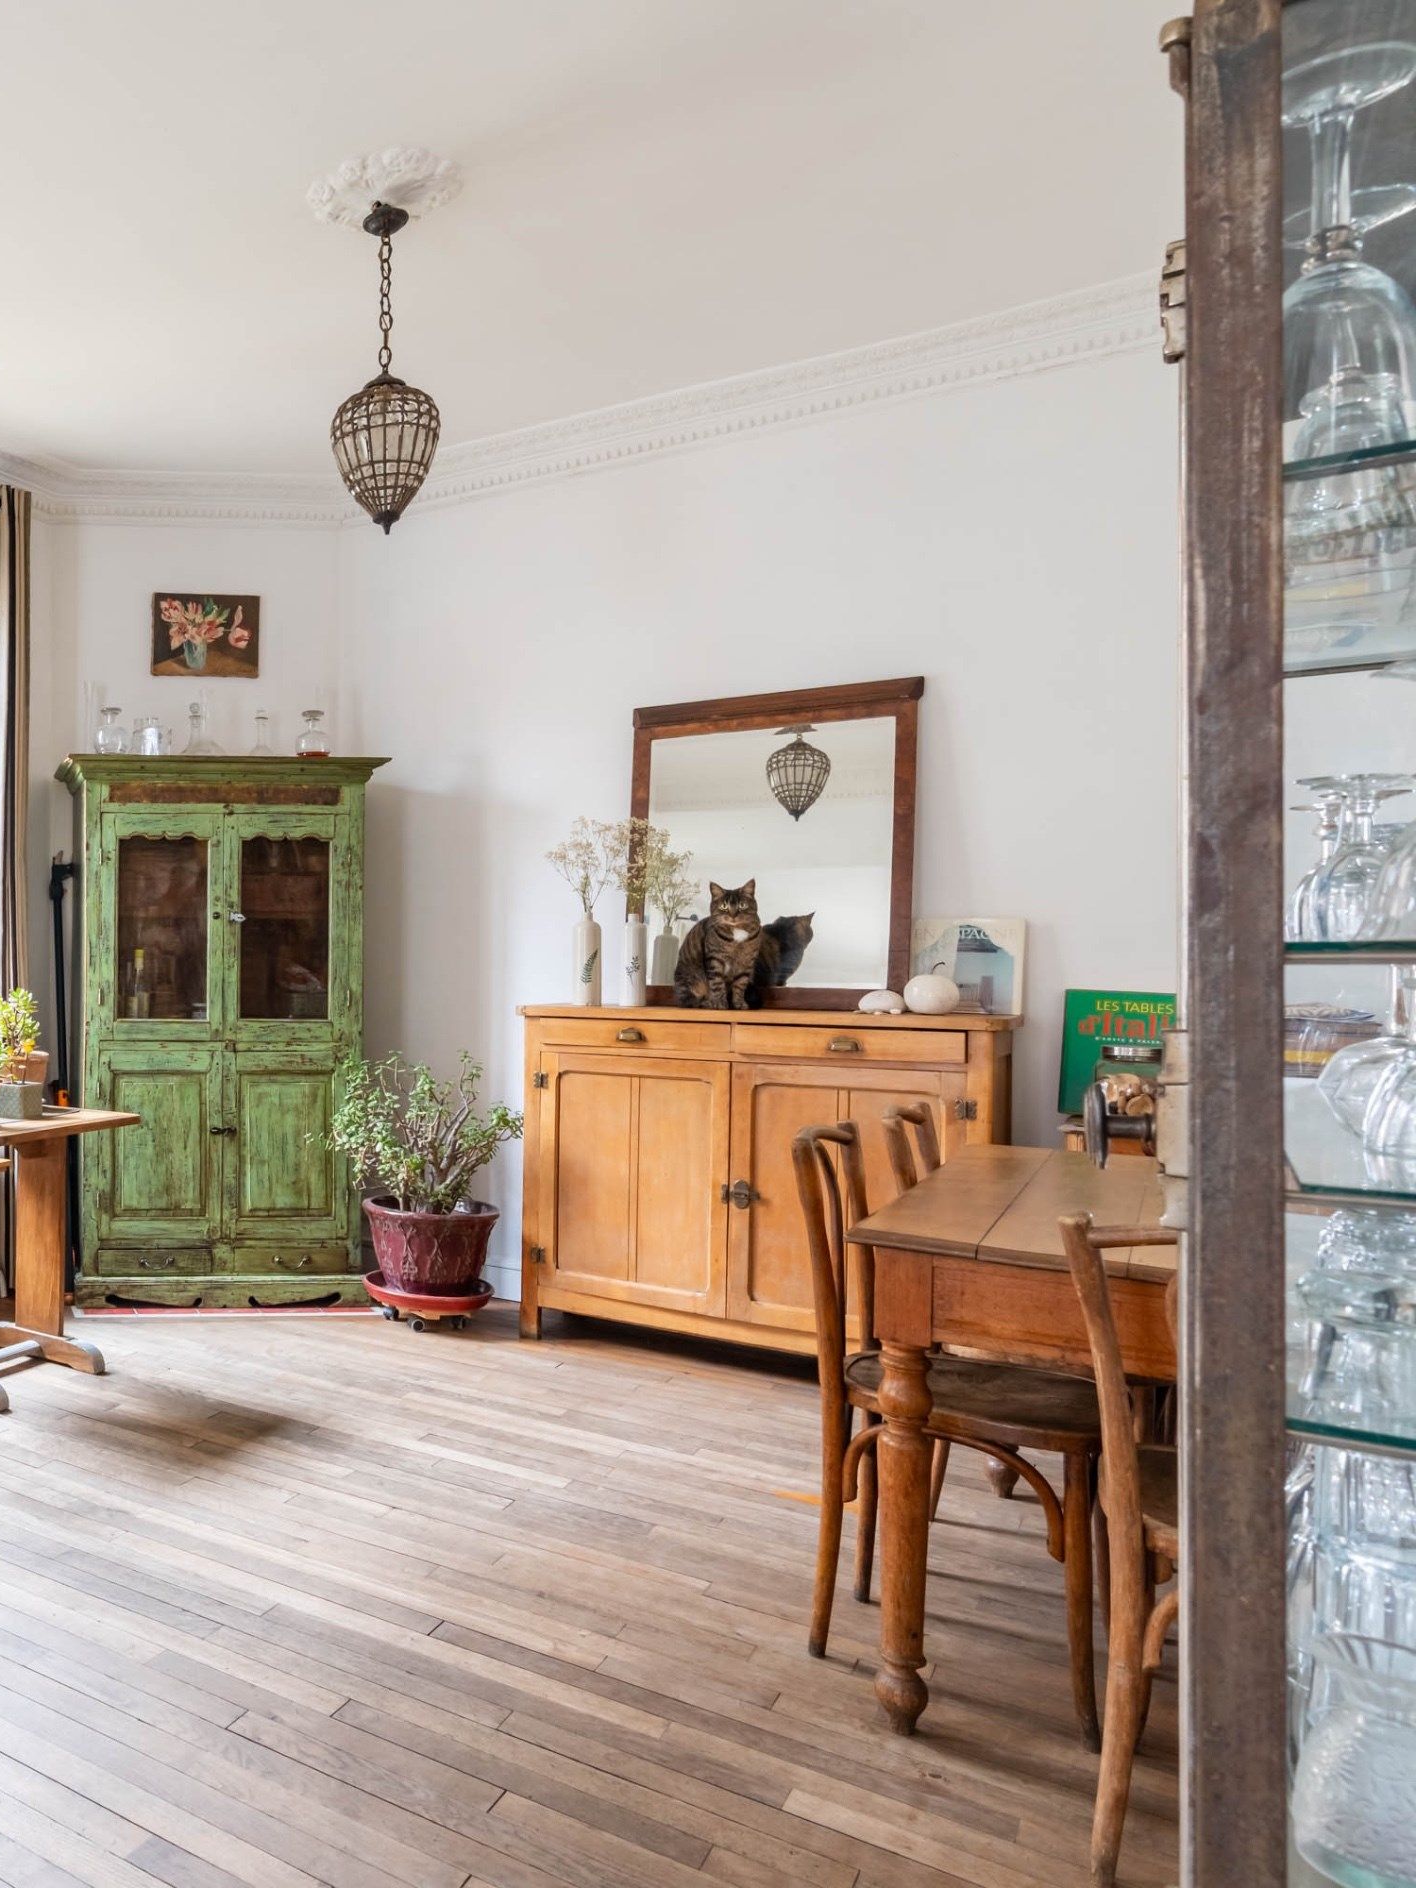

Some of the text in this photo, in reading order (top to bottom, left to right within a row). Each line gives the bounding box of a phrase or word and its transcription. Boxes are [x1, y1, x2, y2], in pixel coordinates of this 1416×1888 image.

[946, 928, 1017, 941] SPAGNE
[1096, 1000, 1174, 1014] LES TABLES
[1078, 1012, 1177, 1040] d'Itali
